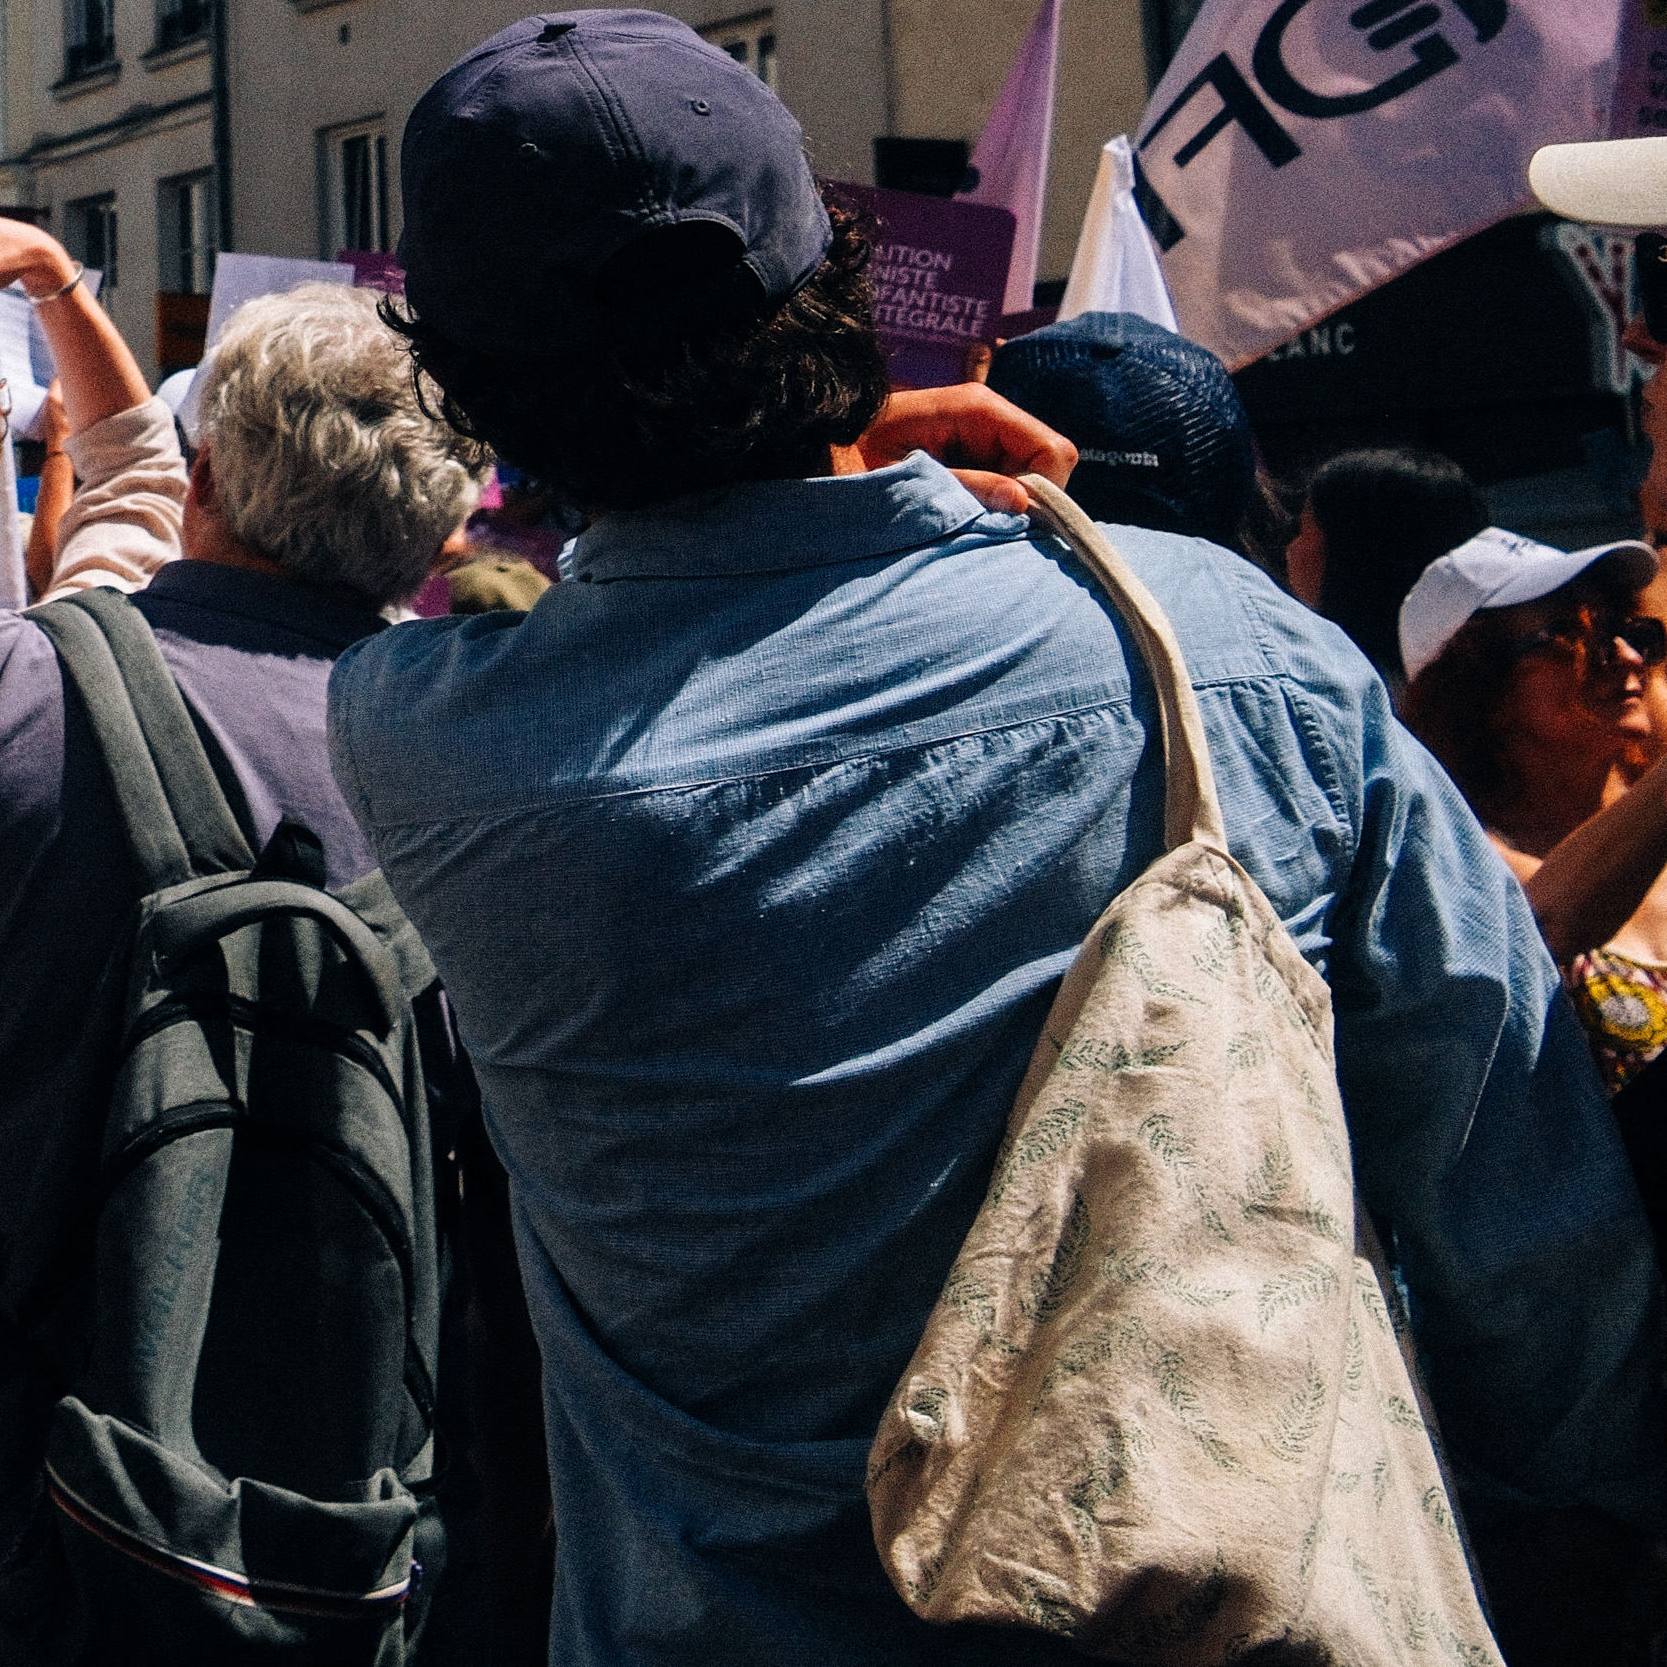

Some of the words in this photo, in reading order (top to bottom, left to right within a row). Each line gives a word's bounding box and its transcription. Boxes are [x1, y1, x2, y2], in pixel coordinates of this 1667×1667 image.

[872, 264, 939, 290] NISTE
[874, 283, 991, 319] FANTISTE
[1078, 448, 1159, 467] atagonia
